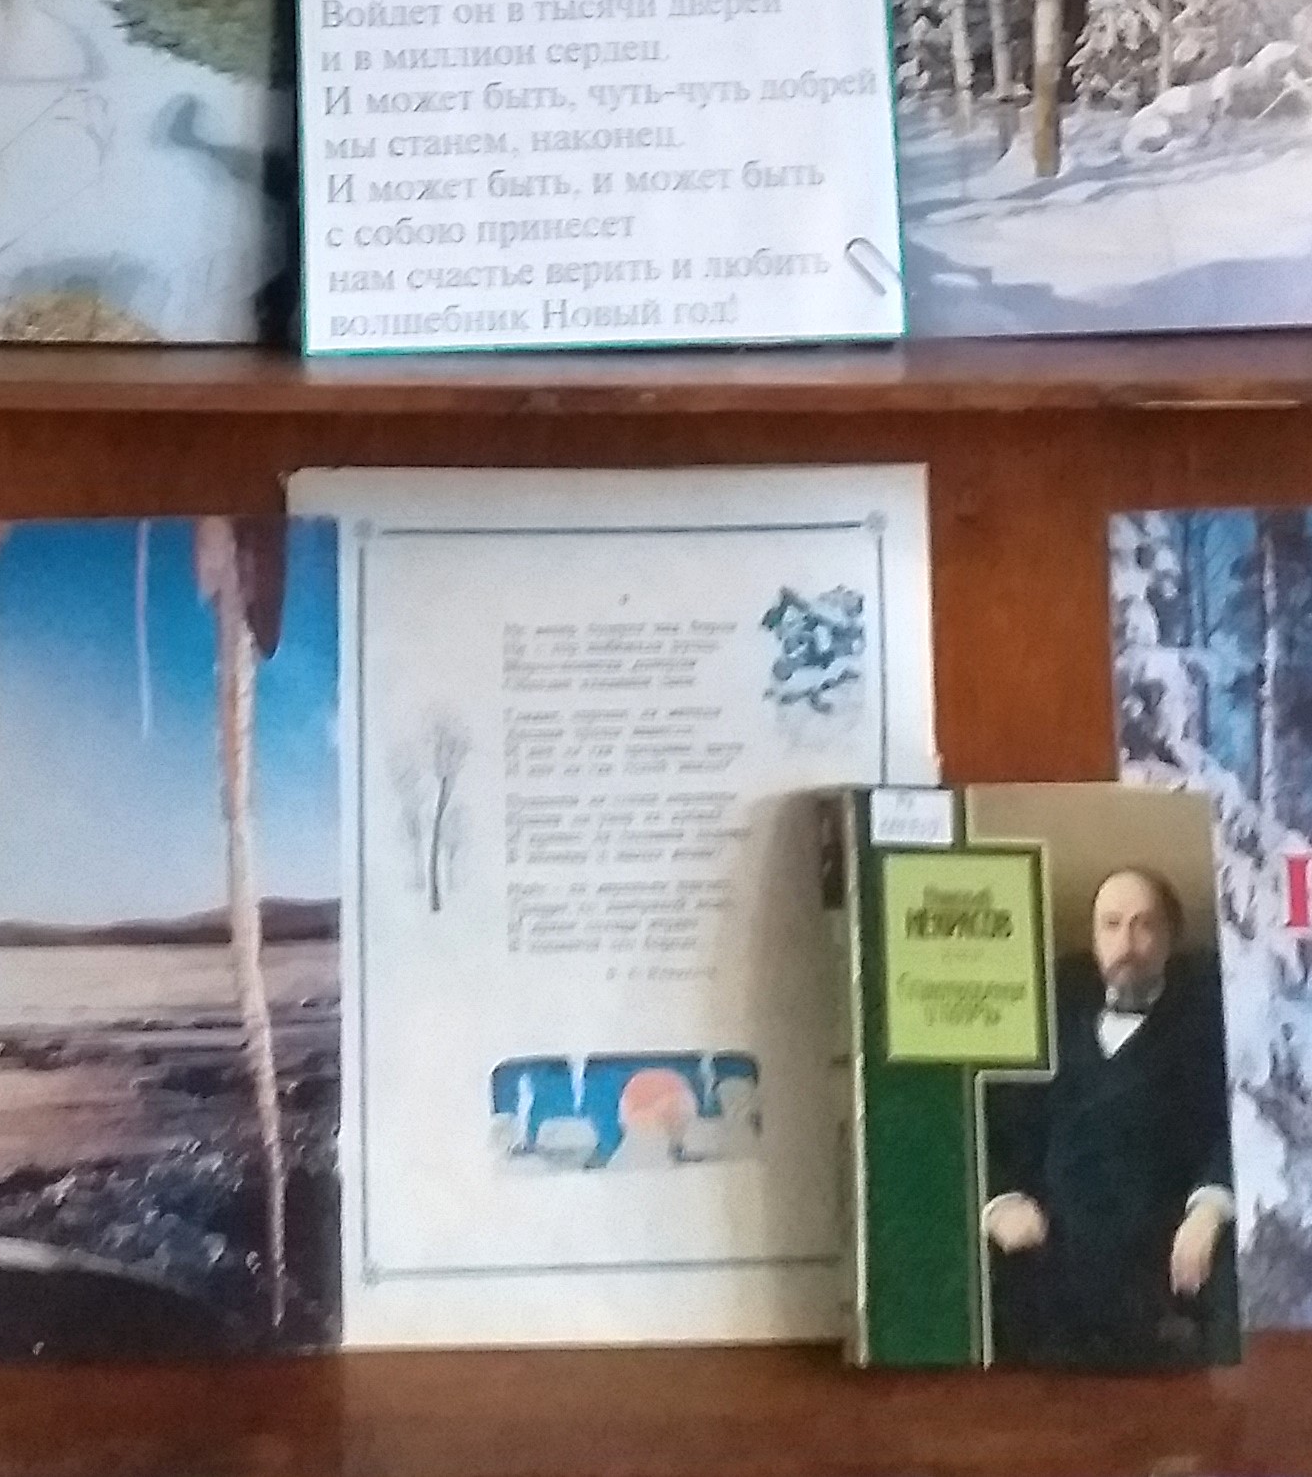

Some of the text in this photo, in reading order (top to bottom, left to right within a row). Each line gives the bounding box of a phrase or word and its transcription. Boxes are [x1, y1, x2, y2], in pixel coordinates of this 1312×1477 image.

[451, 1, 497, 26] он
[320, 48, 344, 74] и
[353, 47, 374, 73] в
[381, 44, 538, 71] миллион
[323, 87, 354, 117] И
[365, 88, 476, 114] может
[586, 80, 753, 110] чуть-чуть
[757, 72, 877, 105] добрей
[323, 134, 379, 160] мы
[326, 174, 358, 203] И
[366, 176, 479, 201] может
[590, 169, 615, 196] и
[624, 167, 735, 193] может
[740, 160, 827, 190] быть
[324, 213, 638, 249] с собою принесет
[327, 251, 832, 293] нам счастье верить и любить
[329, 296, 739, 334] волшебник Новый год!
